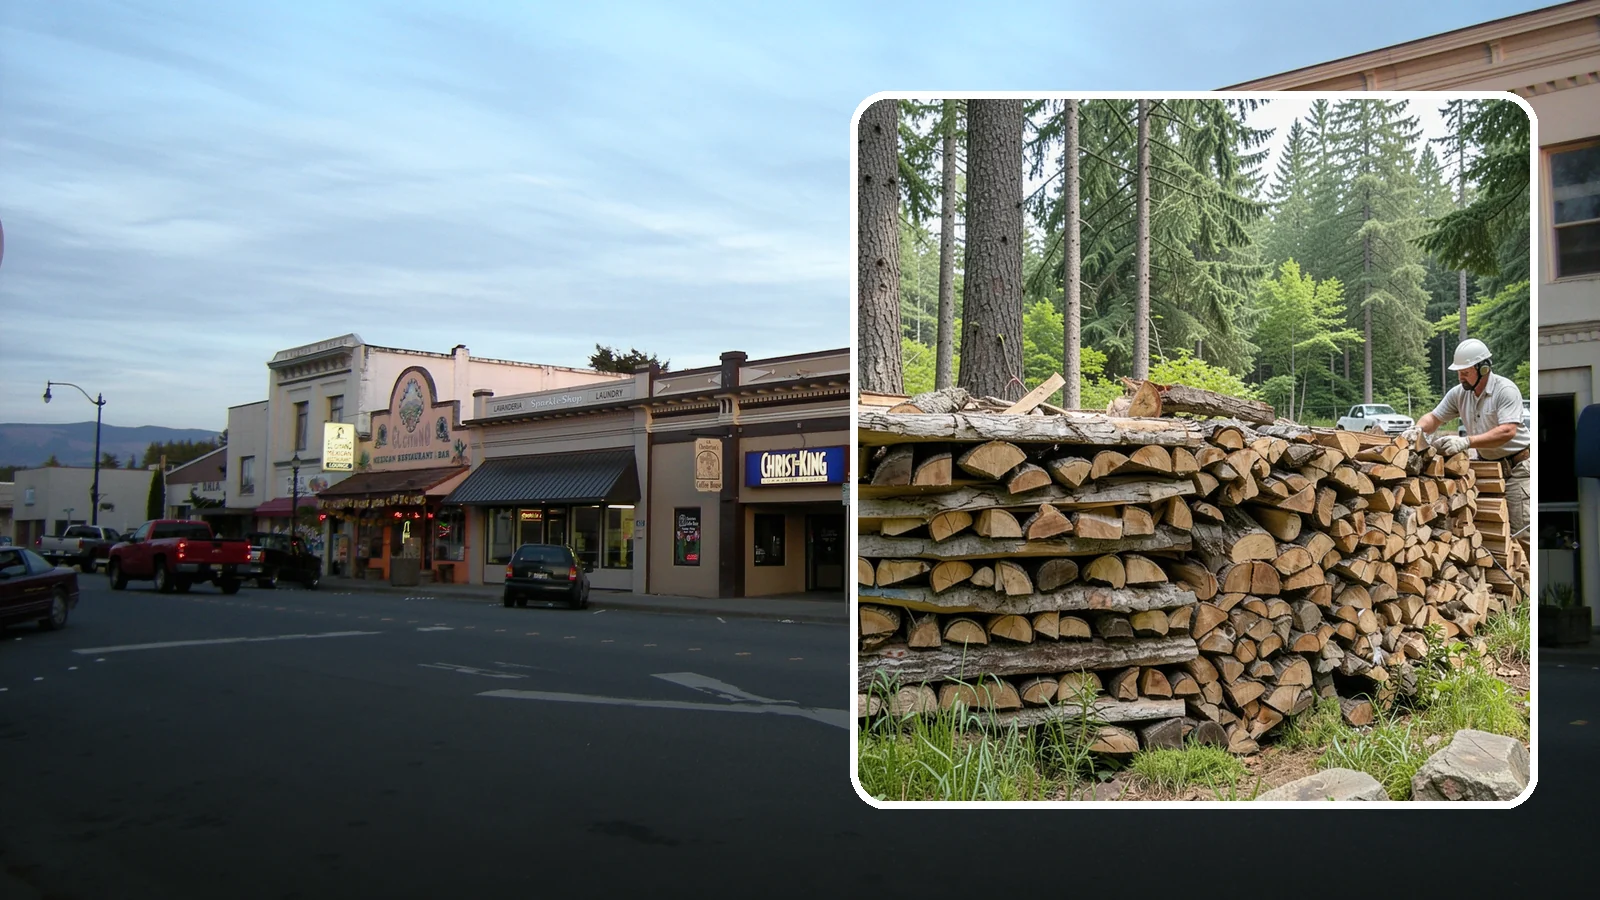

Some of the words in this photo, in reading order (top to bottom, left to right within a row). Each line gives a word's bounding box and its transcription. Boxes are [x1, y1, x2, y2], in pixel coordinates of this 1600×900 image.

[493, 402, 523, 413] LAVANDERIA
[530, 396, 560, 409] Sparkle
[562, 394, 582, 405] Shop
[595, 389, 624, 400] LAUNDRY
[397, 451, 434, 462] RESTAURANT
[437, 449, 450, 458] BAR
[761, 452, 798, 478] CHRIST
[799, 449, 828, 476] KING
